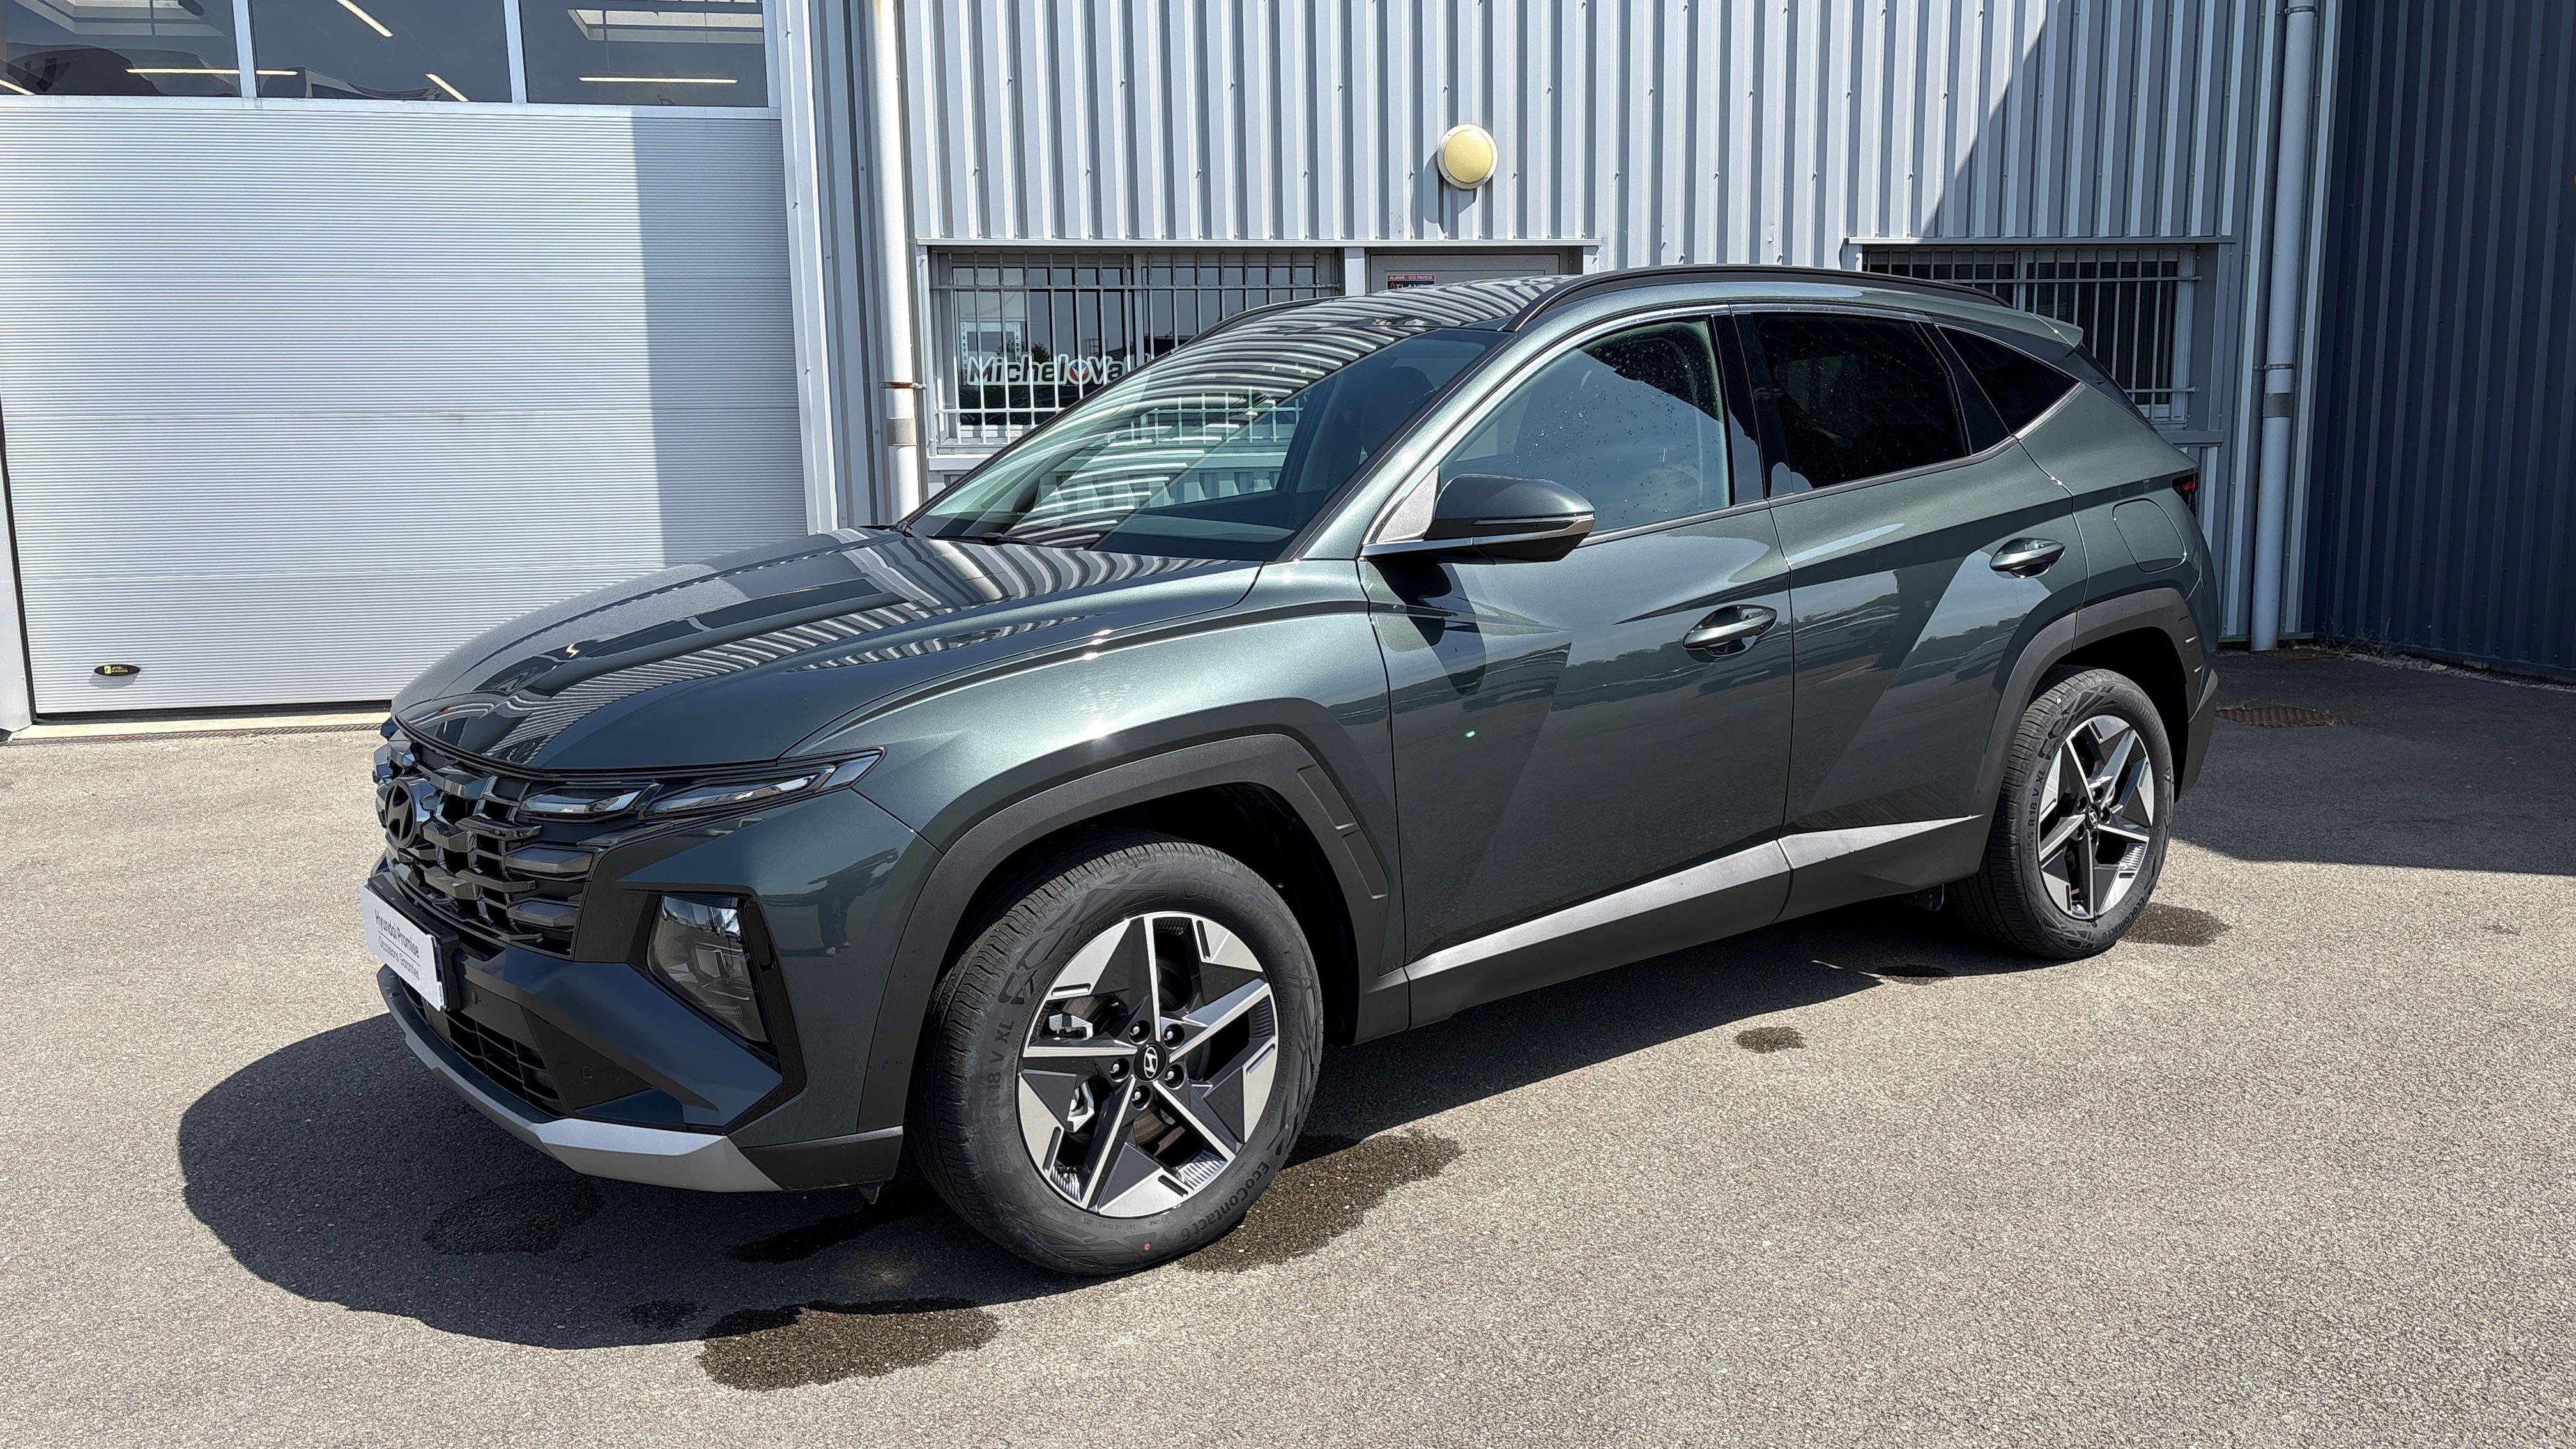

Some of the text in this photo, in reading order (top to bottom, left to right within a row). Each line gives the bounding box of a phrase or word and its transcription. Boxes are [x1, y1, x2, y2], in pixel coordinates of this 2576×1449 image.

[966, 353, 1071, 385] Michel
[374, 909, 397, 940] Hyundai
[2107, 896, 2145, 938] EcoContact
[994, 1020, 1015, 1045] XL
[988, 1050, 1005, 1064] V
[1194, 1160, 1270, 1236] EcoContact
[1180, 1227, 1192, 1243] 6
